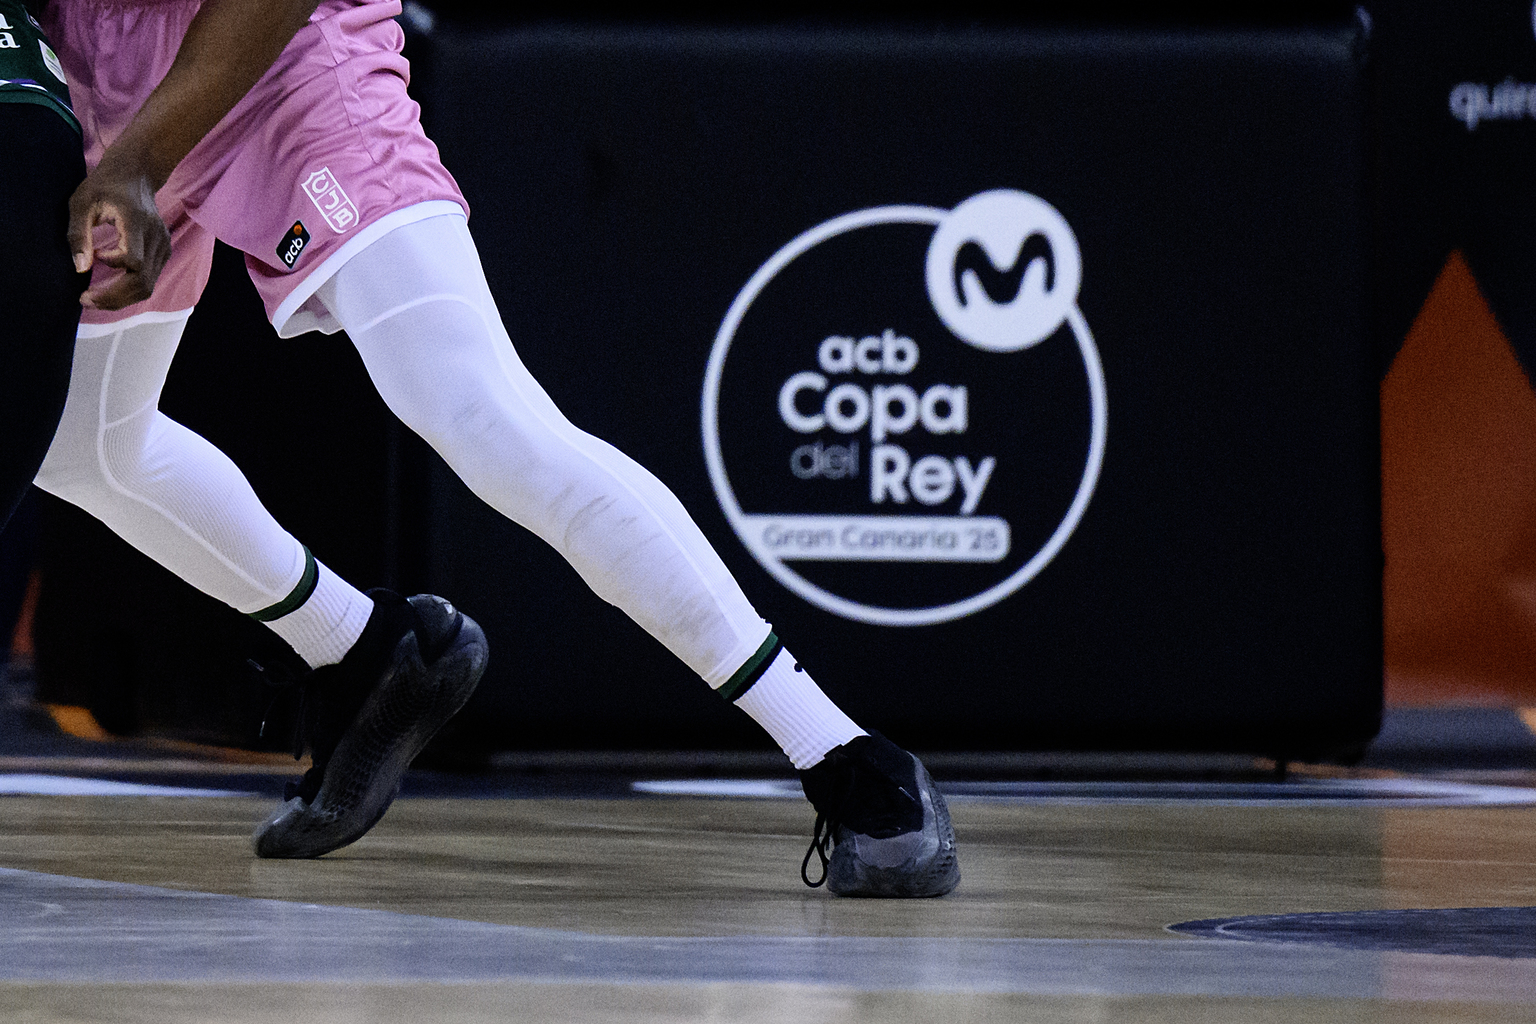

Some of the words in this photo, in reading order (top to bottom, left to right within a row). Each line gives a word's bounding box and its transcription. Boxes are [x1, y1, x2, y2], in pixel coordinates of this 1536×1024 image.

[284, 237, 304, 265] acb
[818, 329, 920, 375] acb
[777, 371, 970, 443] Copa
[789, 441, 860, 480] del
[869, 443, 997, 514] Rey
[763, 525, 835, 551] Gran
[840, 525, 958, 551] Canaria
